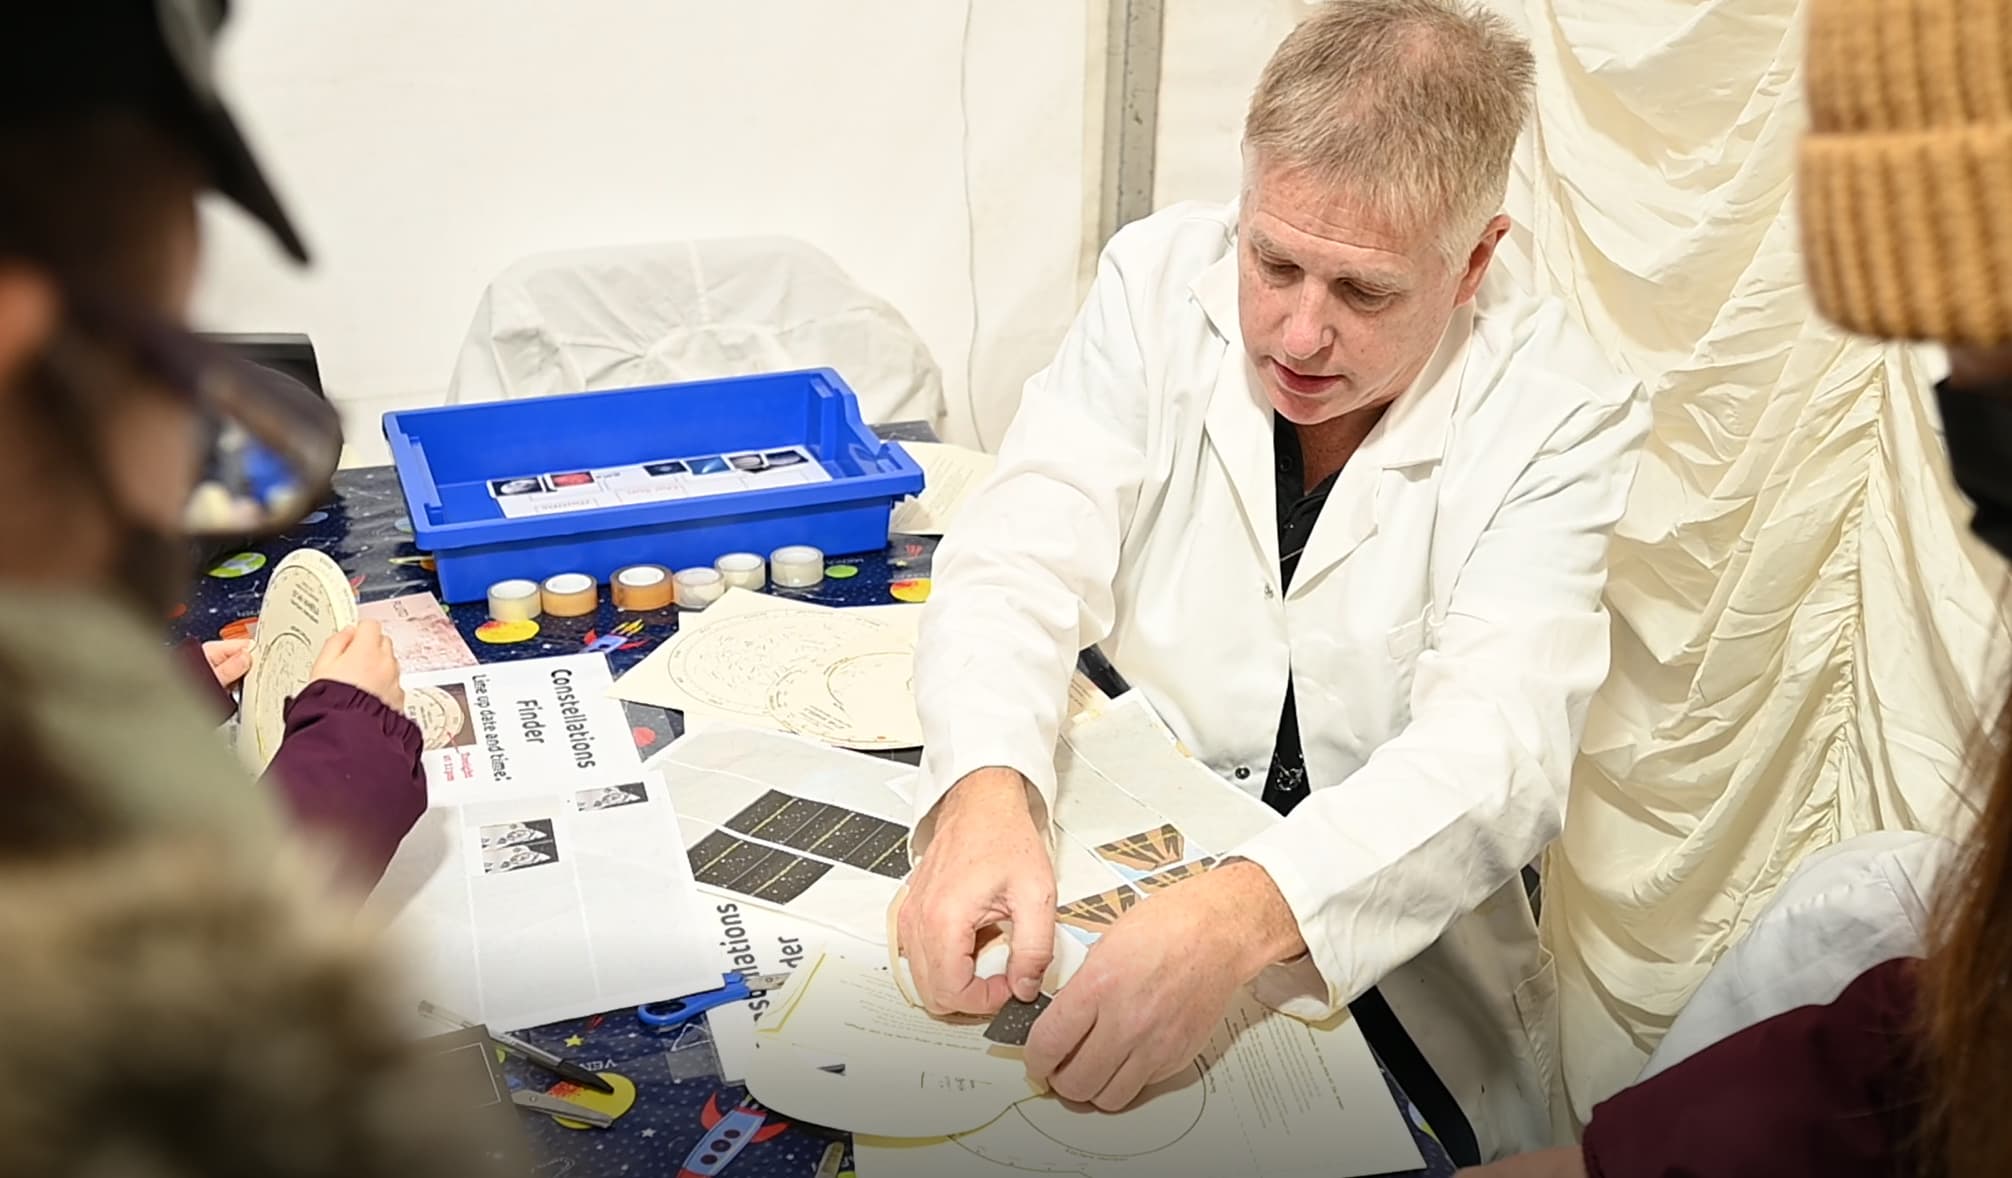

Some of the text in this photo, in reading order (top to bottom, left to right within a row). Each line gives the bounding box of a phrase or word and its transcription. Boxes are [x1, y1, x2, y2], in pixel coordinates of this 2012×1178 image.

[471, 673, 490, 694] Line
[474, 695, 490, 709] up
[479, 709, 497, 732] date
[516, 700, 545, 744] Finder
[550, 668, 596, 769] Constellations
[484, 733, 505, 753] and
[579, 1059, 618, 1072] VEN
